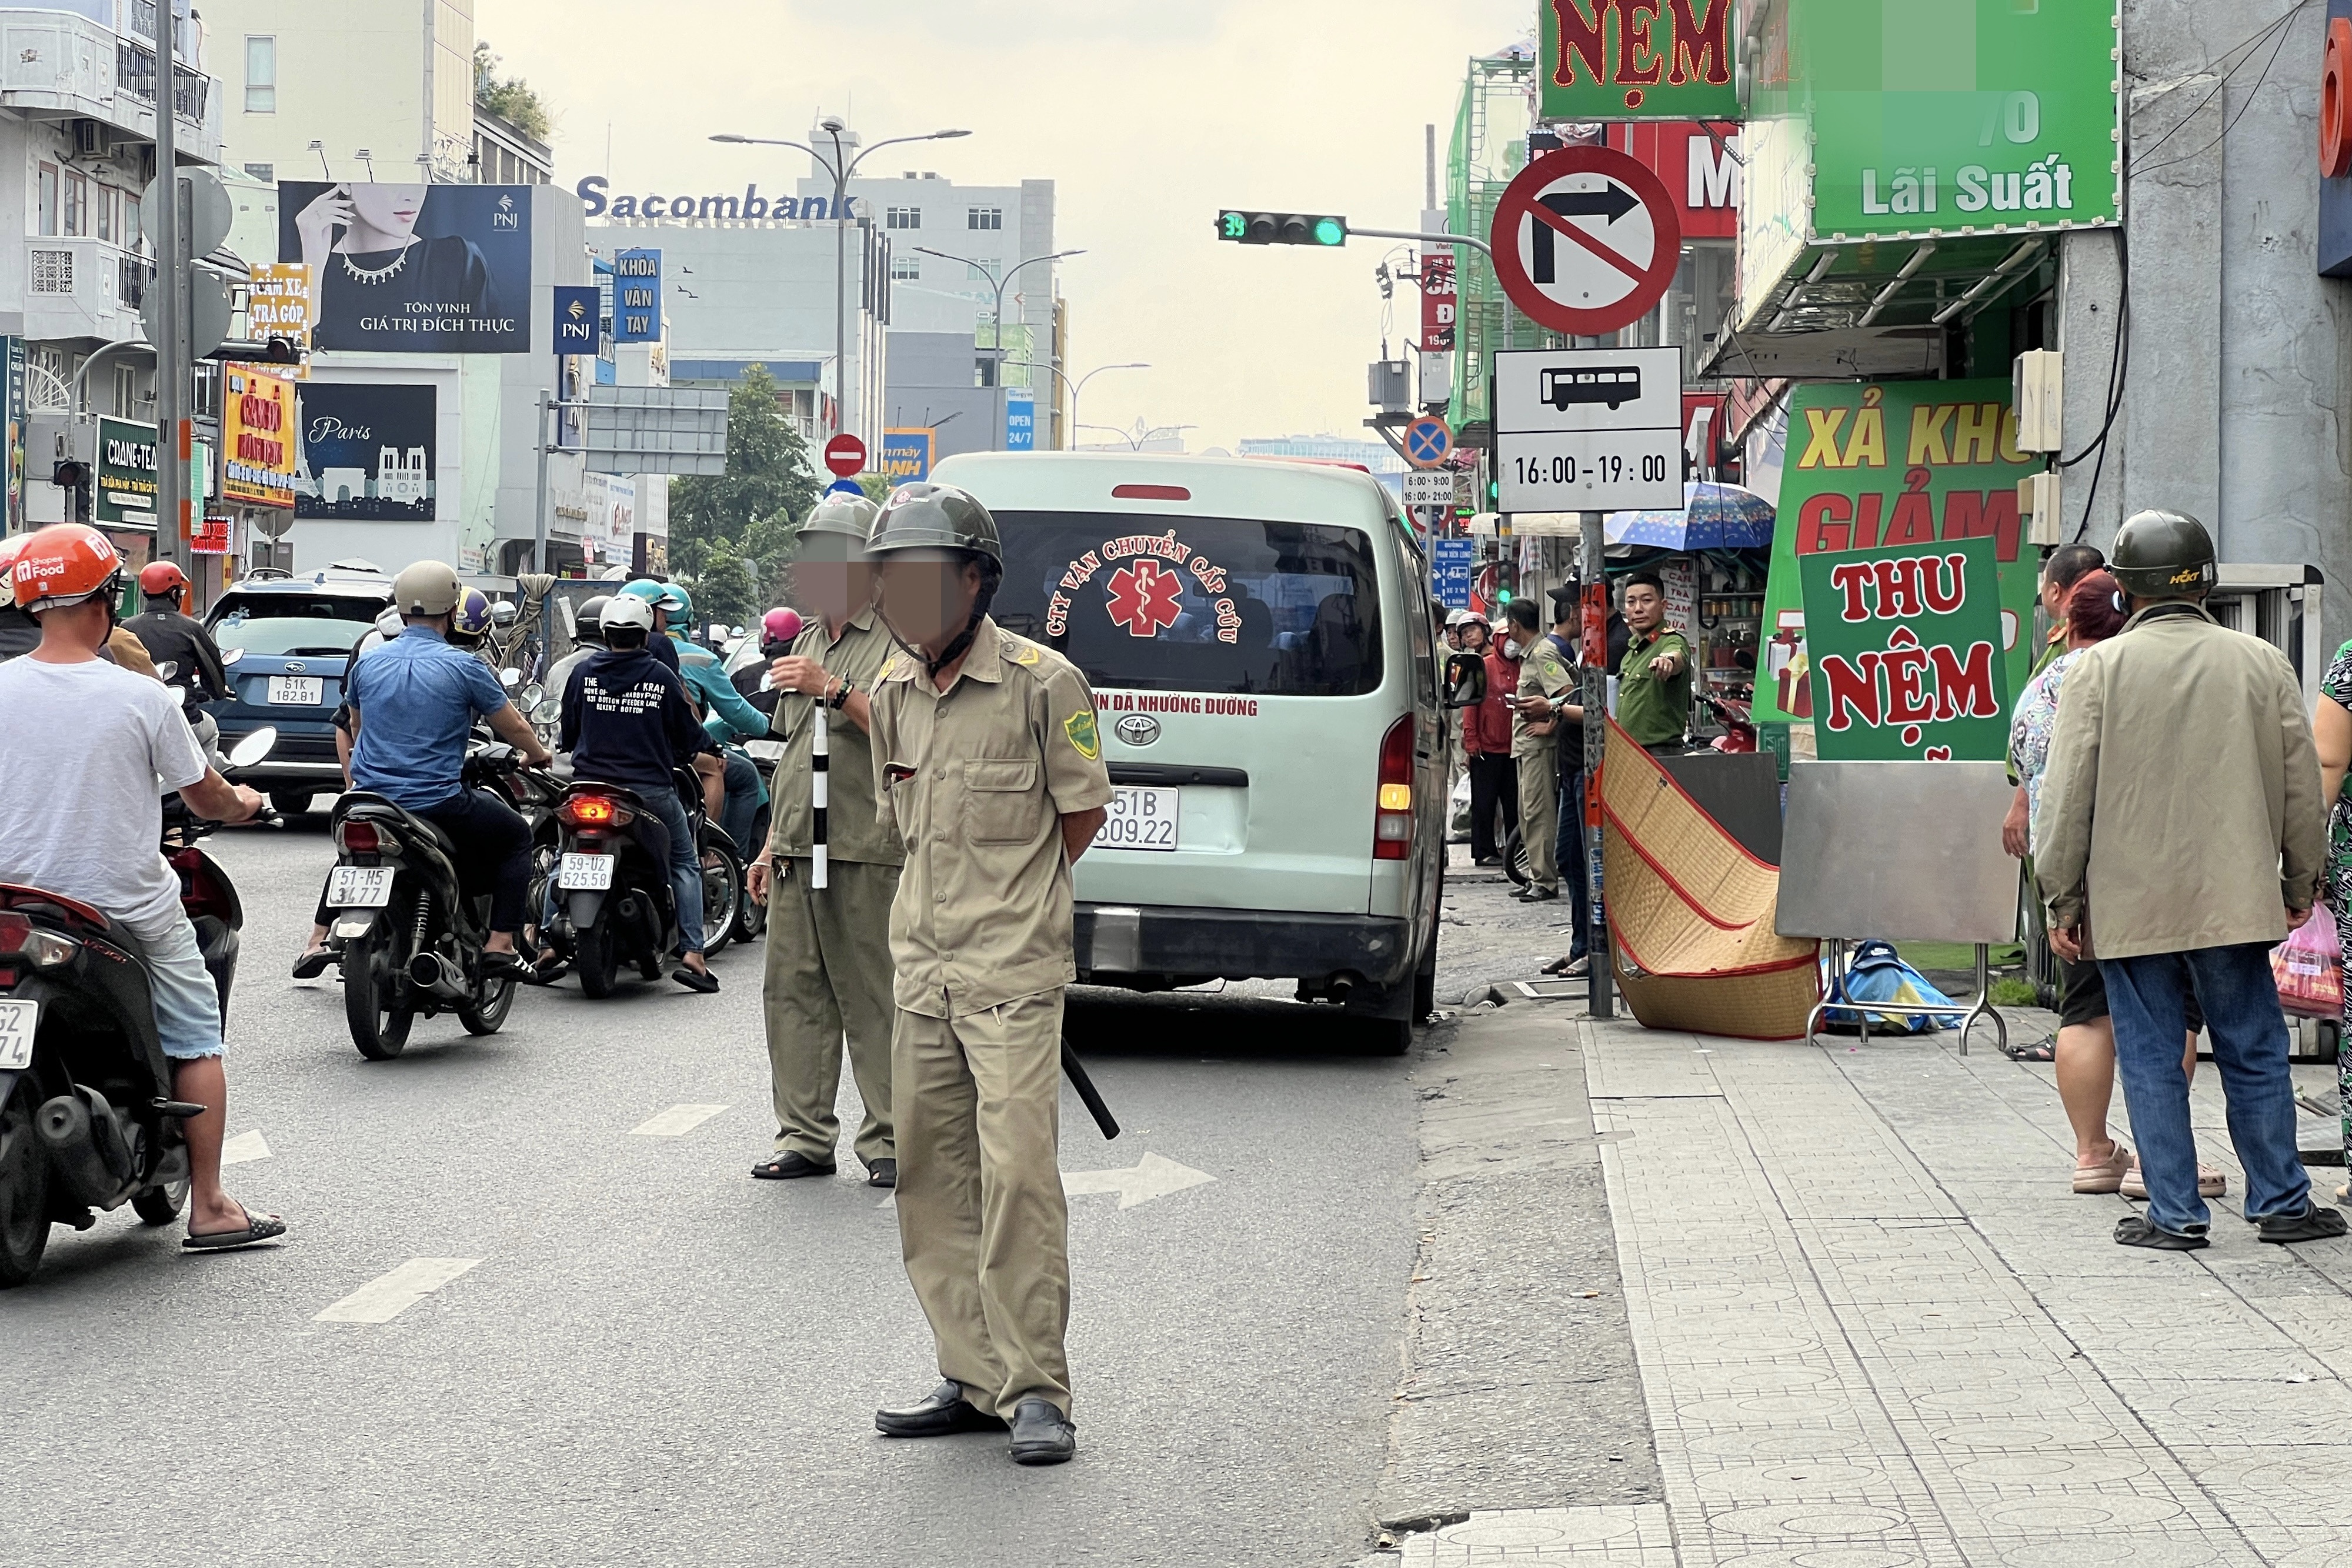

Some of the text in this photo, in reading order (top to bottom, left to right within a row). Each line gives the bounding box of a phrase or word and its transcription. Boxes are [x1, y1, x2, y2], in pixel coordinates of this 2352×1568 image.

[1862, 153, 2073, 214] Lãi Suất
[576, 175, 859, 220] Sacombank
[493, 213, 518, 229] PNJ
[619, 254, 656, 276] KHÓA
[285, 278, 302, 296] XE
[625, 286, 652, 307] VÂN
[254, 298, 303, 323] TRẢ GÓP
[404, 301, 470, 313] TÔN VINH
[360, 315, 515, 334] GIÁ TRỊ ĐÍCH THỰC
[562, 323, 590, 341] PNJ
[626, 316, 649, 333] TAY
[1009, 415, 1031, 426] OPEN
[1797, 386, 1887, 469] XẢ
[308, 415, 372, 443] Paris
[1009, 432, 1031, 443] 24/7
[893, 446, 921, 459] máy
[1409, 477, 1426, 486] 6:00
[1434, 477, 1449, 486] 9:00
[1404, 492, 1426, 501] 16:00
[1433, 492, 1452, 501] 21:00
[1796, 467, 2021, 562] GIẢM
[32, 556, 64, 566] Shopee
[32, 563, 65, 578] Food
[1046, 529, 1242, 644] CTY VẬN CHUYỂN CẤP CỨU
[1672, 588, 1689, 598] TRÀ
[1831, 553, 1967, 623] THU
[1666, 603, 1691, 613] CAM
[285, 678, 306, 689] 61K
[584, 677, 598, 686] THE
[643, 682, 665, 694] KRAB
[1820, 625, 2000, 748] NỆM
[276, 690, 313, 701] 182.81
[598, 696, 619, 705] BOTTOM
[596, 703, 616, 712] BIKINI
[1113, 692, 1134, 711] ĐÃ
[1138, 694, 1201, 713] NHƯỜNG
[1205, 696, 1257, 716] ĐƯỜNG
[1114, 790, 1156, 816] 51B
[569, 857, 605, 871] 59-U2
[341, 870, 384, 885] 51-H5
[563, 872, 606, 886] 525.58
